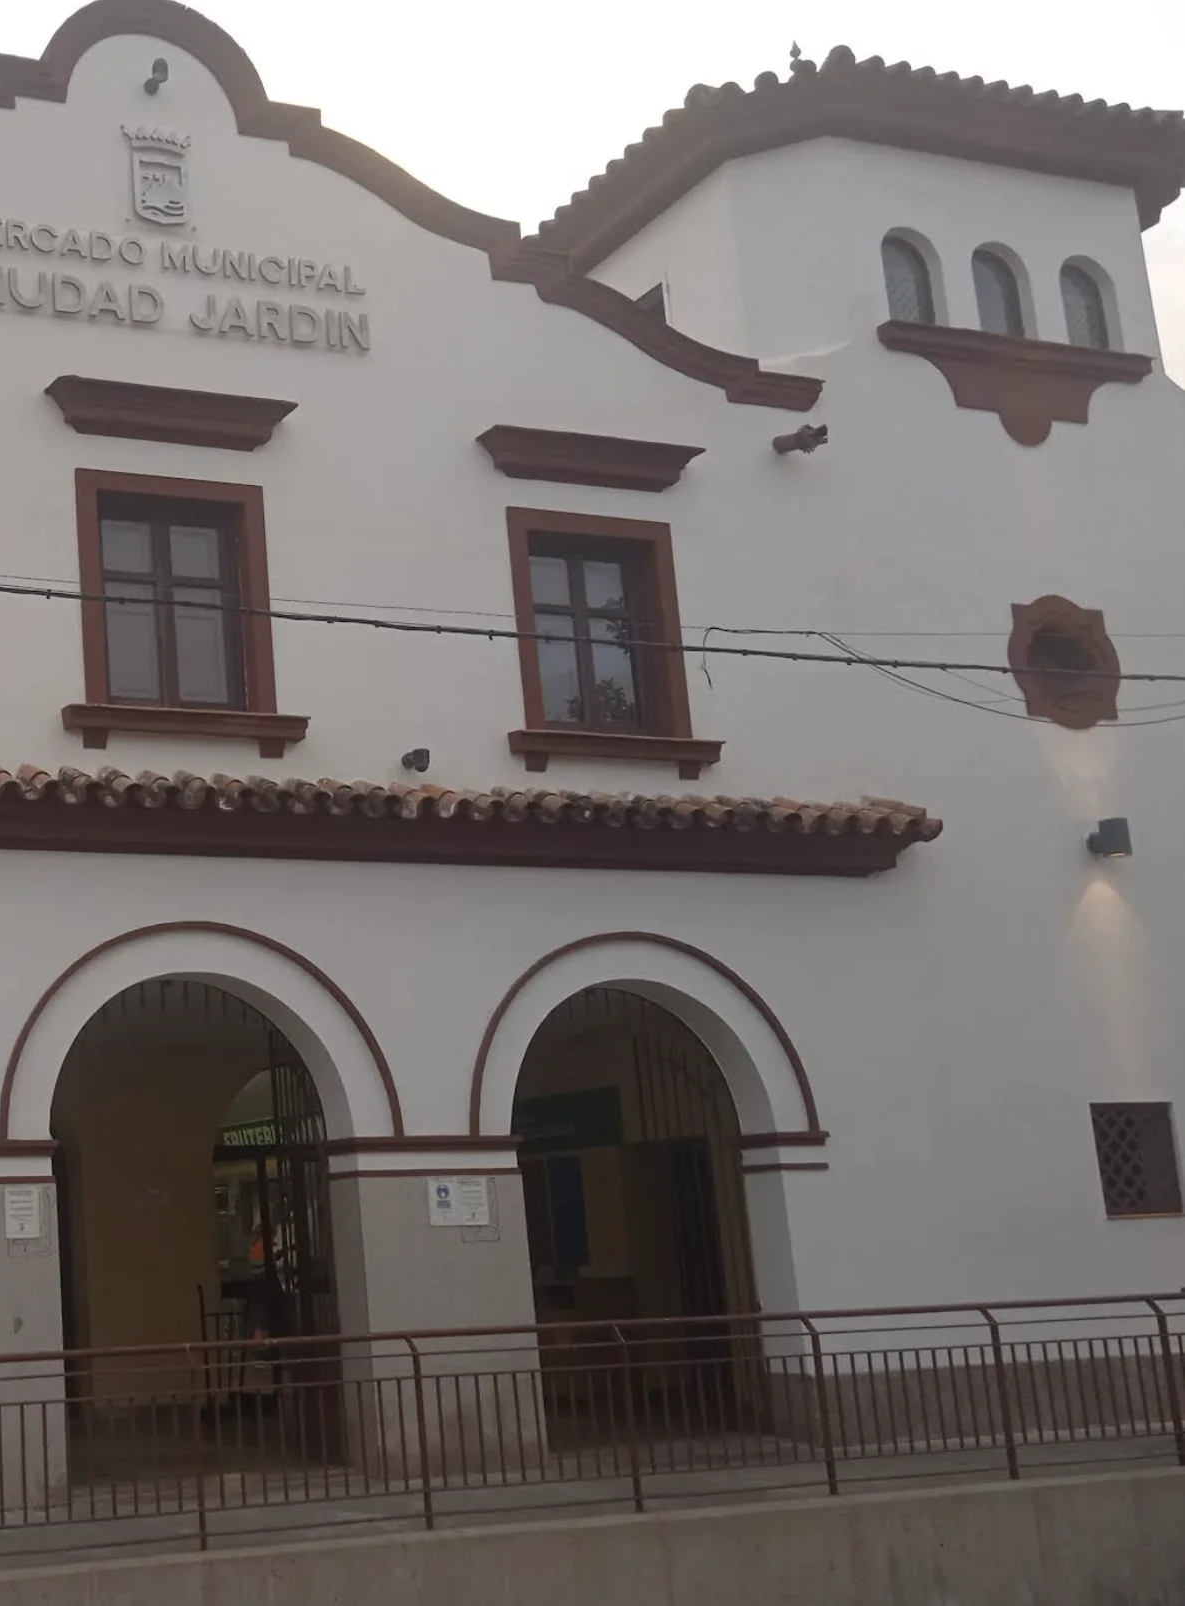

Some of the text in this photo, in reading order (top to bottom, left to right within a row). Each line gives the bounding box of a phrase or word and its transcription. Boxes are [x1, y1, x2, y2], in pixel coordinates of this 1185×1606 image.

[160, 240, 366, 296] MUNICIPAL
[189, 294, 371, 352] JARDIN
[222, 1124, 277, 1146] FRUTERI
